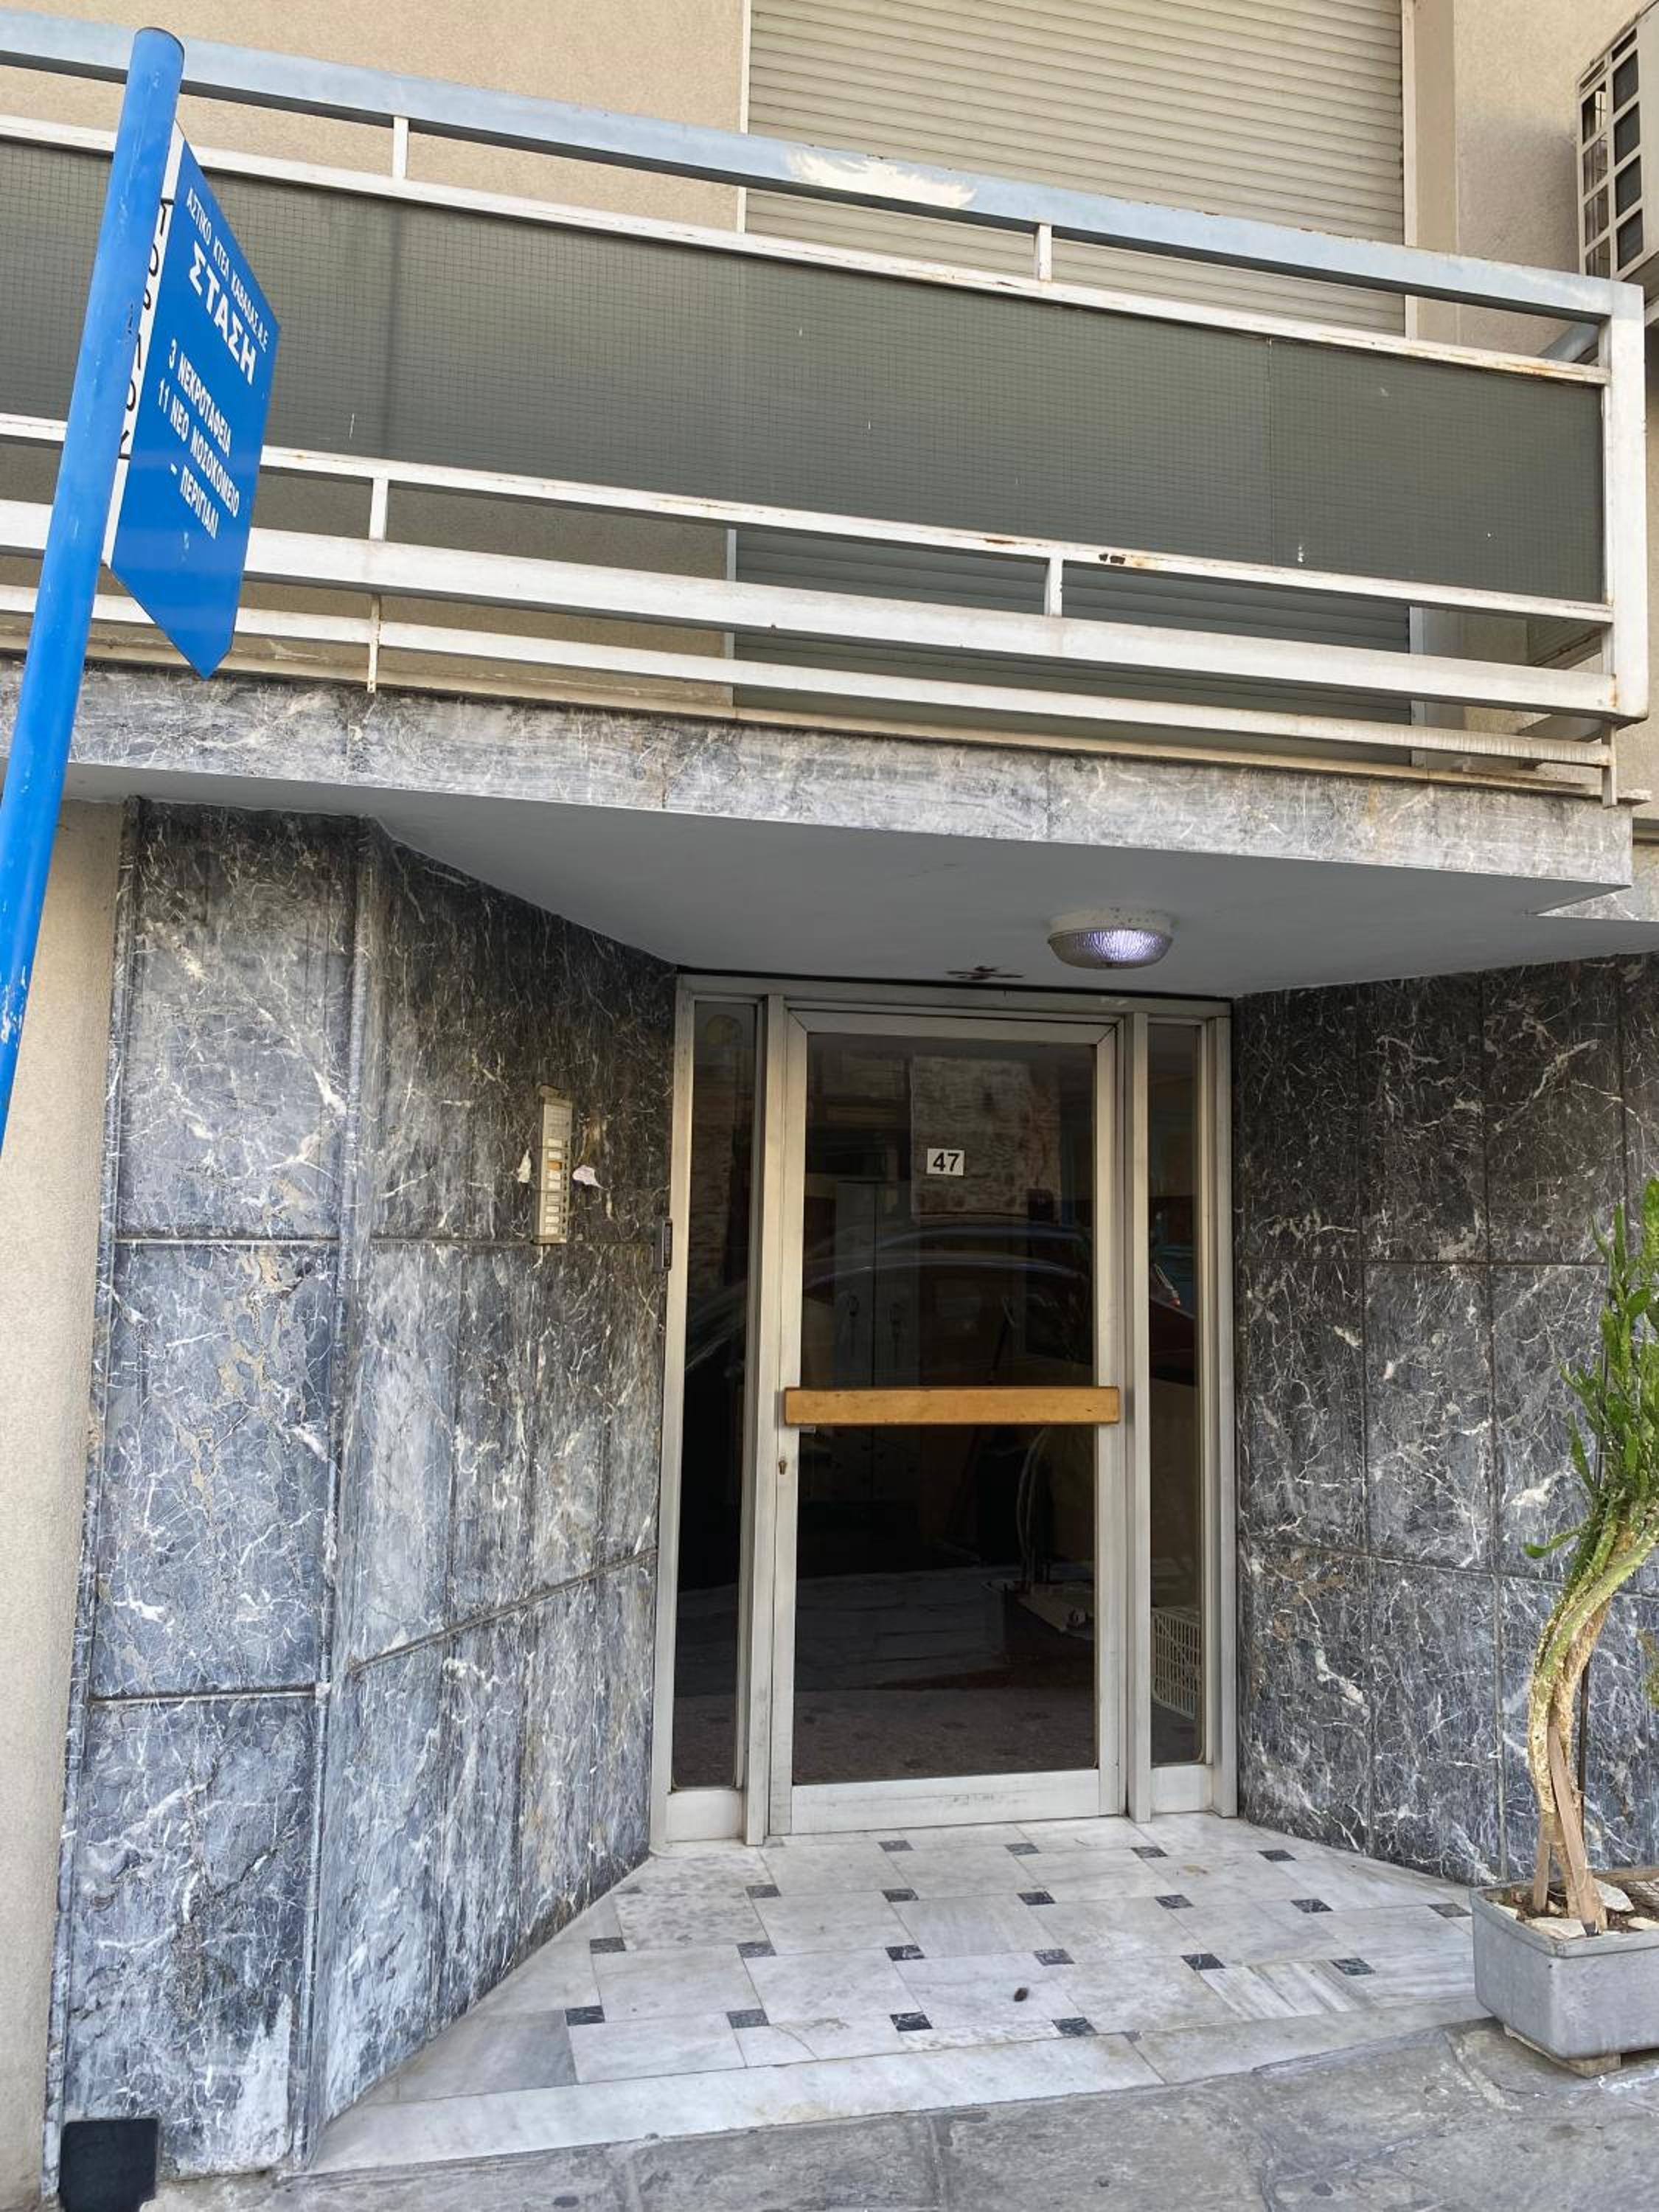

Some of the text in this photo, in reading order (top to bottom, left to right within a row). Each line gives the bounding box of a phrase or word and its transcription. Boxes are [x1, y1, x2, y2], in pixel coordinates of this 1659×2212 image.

[189, 240, 257, 386] ΣΤΑΣΗ
[213, 235, 229, 282] ΚΤΕΛ
[158, 378, 240, 518] 11 ΝΕΟ ΝΟΣΟΚΟΜΕΙΟ
[169, 338, 232, 458] 3 ΝΕΚΡΟΤΑΦΕΙΑ
[932, 1152, 960, 1172] 47
